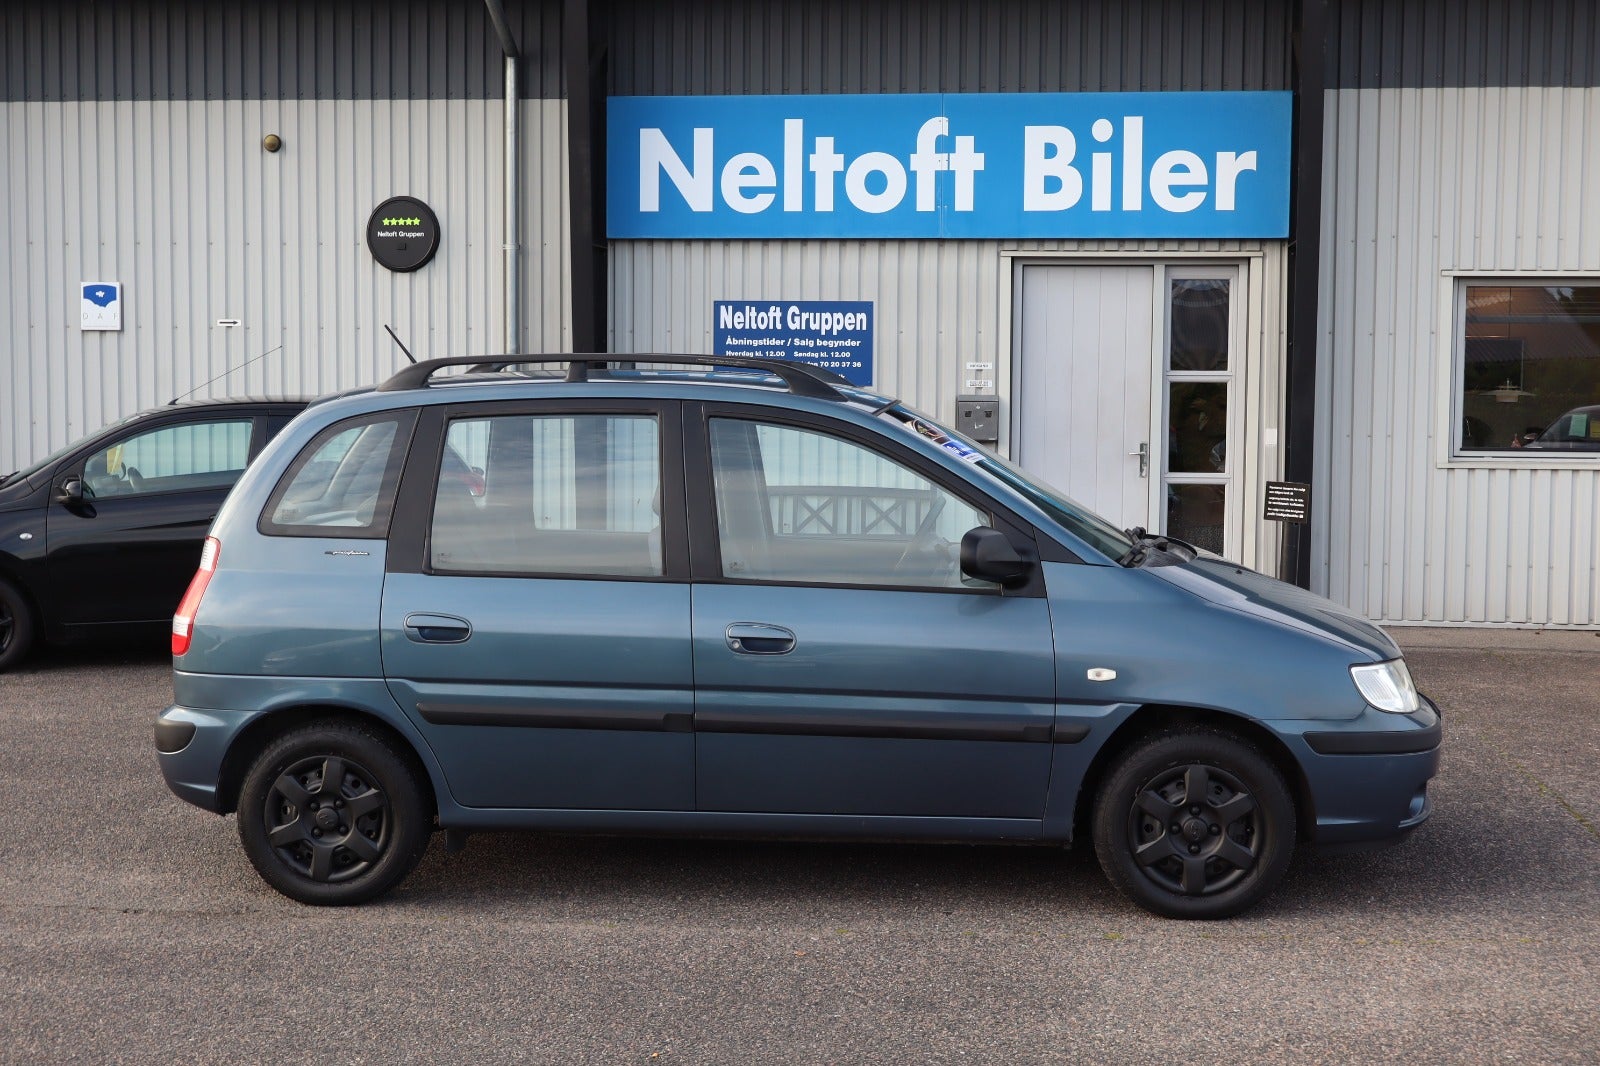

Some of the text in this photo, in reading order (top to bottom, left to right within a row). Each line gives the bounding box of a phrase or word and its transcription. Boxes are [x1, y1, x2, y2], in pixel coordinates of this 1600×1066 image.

[640, 116, 1257, 213] Neltoft Biler
[719, 305, 867, 335] Neltoft Gruppen
[725, 335, 861, 348] Åbningstider / Salg begynder
